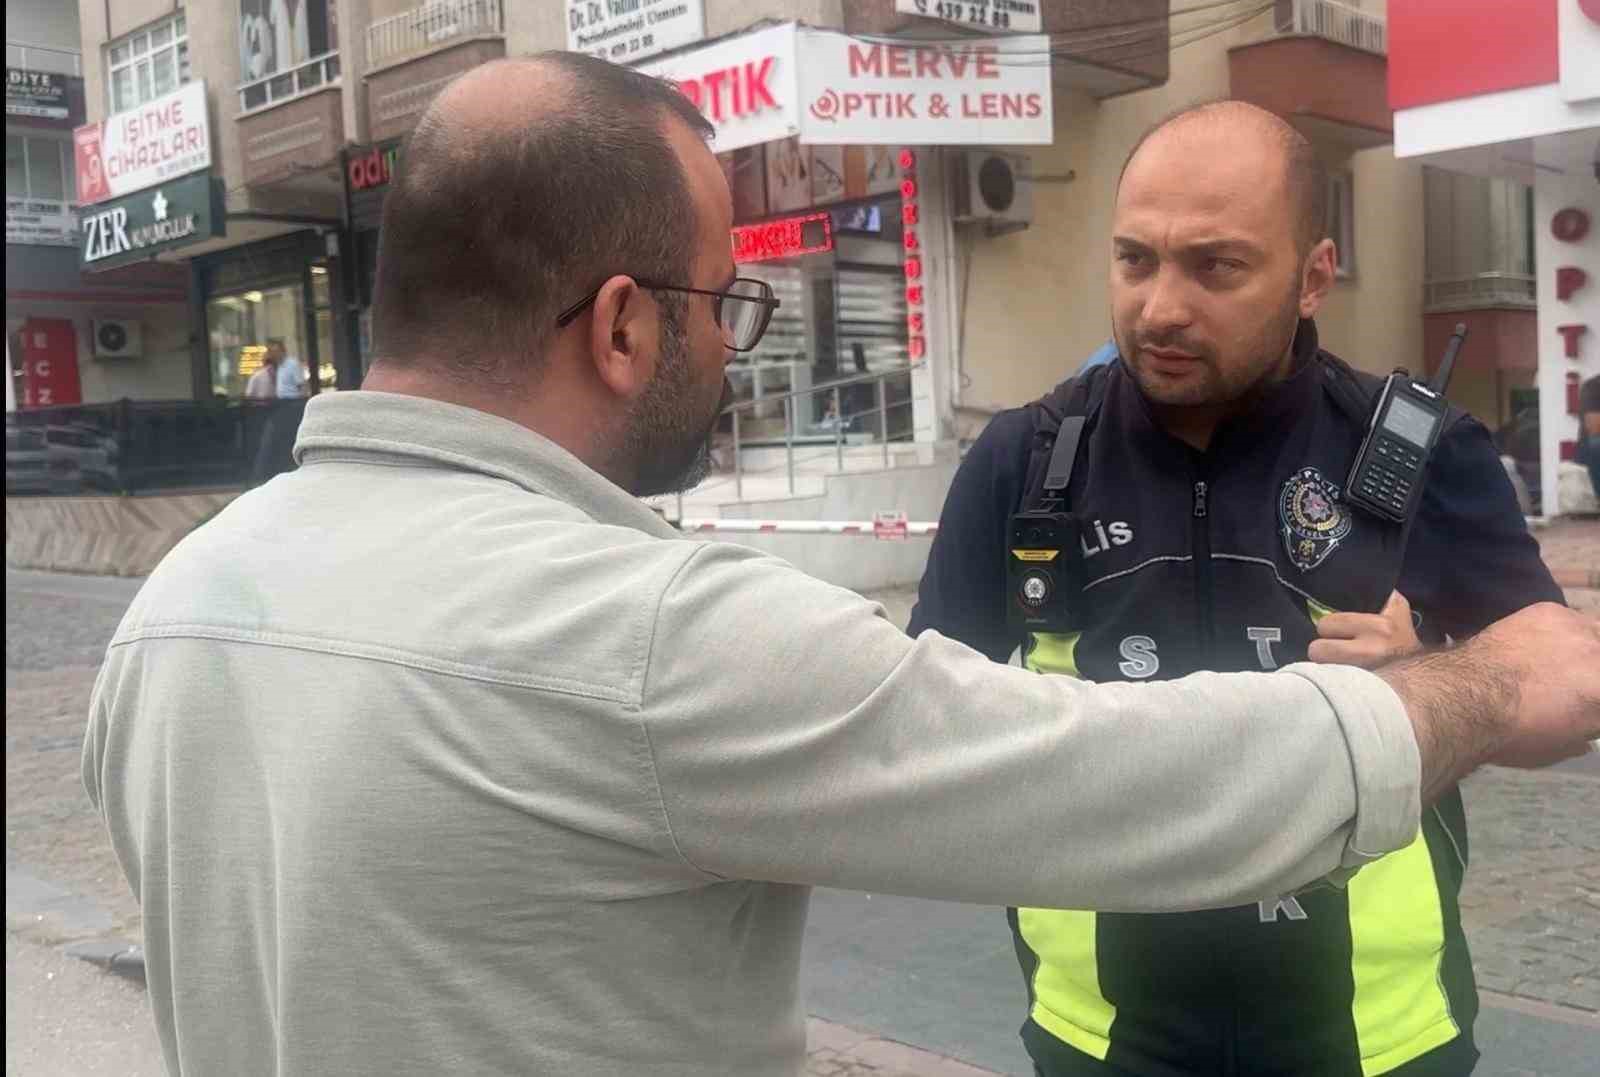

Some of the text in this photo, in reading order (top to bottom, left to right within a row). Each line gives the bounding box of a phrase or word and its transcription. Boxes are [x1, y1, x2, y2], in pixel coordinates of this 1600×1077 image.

[848, 44, 999, 79] MERVE
[928, 92, 950, 119] &
[961, 93, 1043, 119] LENS
[82, 206, 132, 262] ZER
[1118, 635, 1160, 678] S
